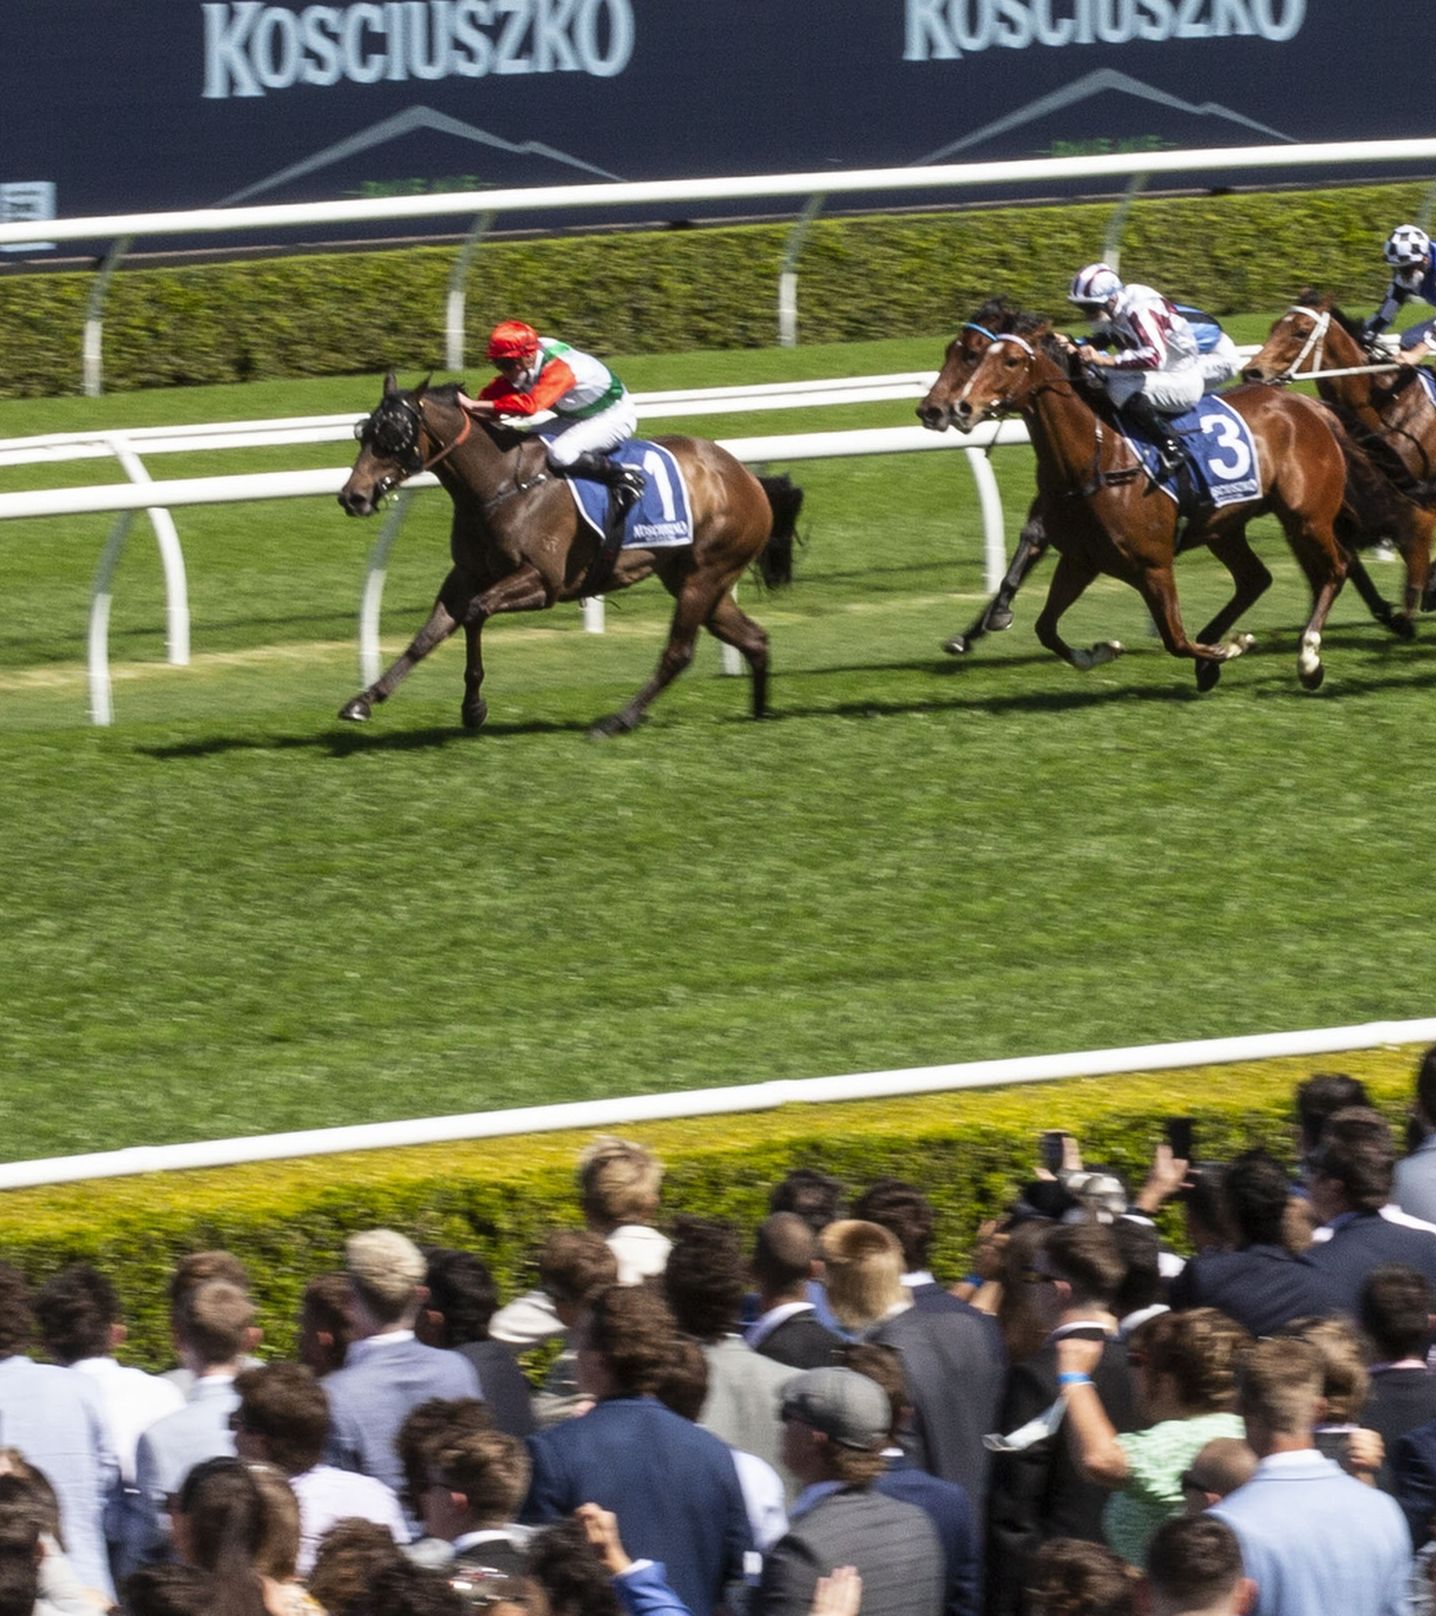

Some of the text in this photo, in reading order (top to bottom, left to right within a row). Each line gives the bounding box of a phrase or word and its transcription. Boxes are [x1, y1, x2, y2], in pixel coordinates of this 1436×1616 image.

[202, 0, 636, 98] KOSCIUSZKO
[1200, 414, 1251, 480] 3
[643, 450, 676, 521] 1
